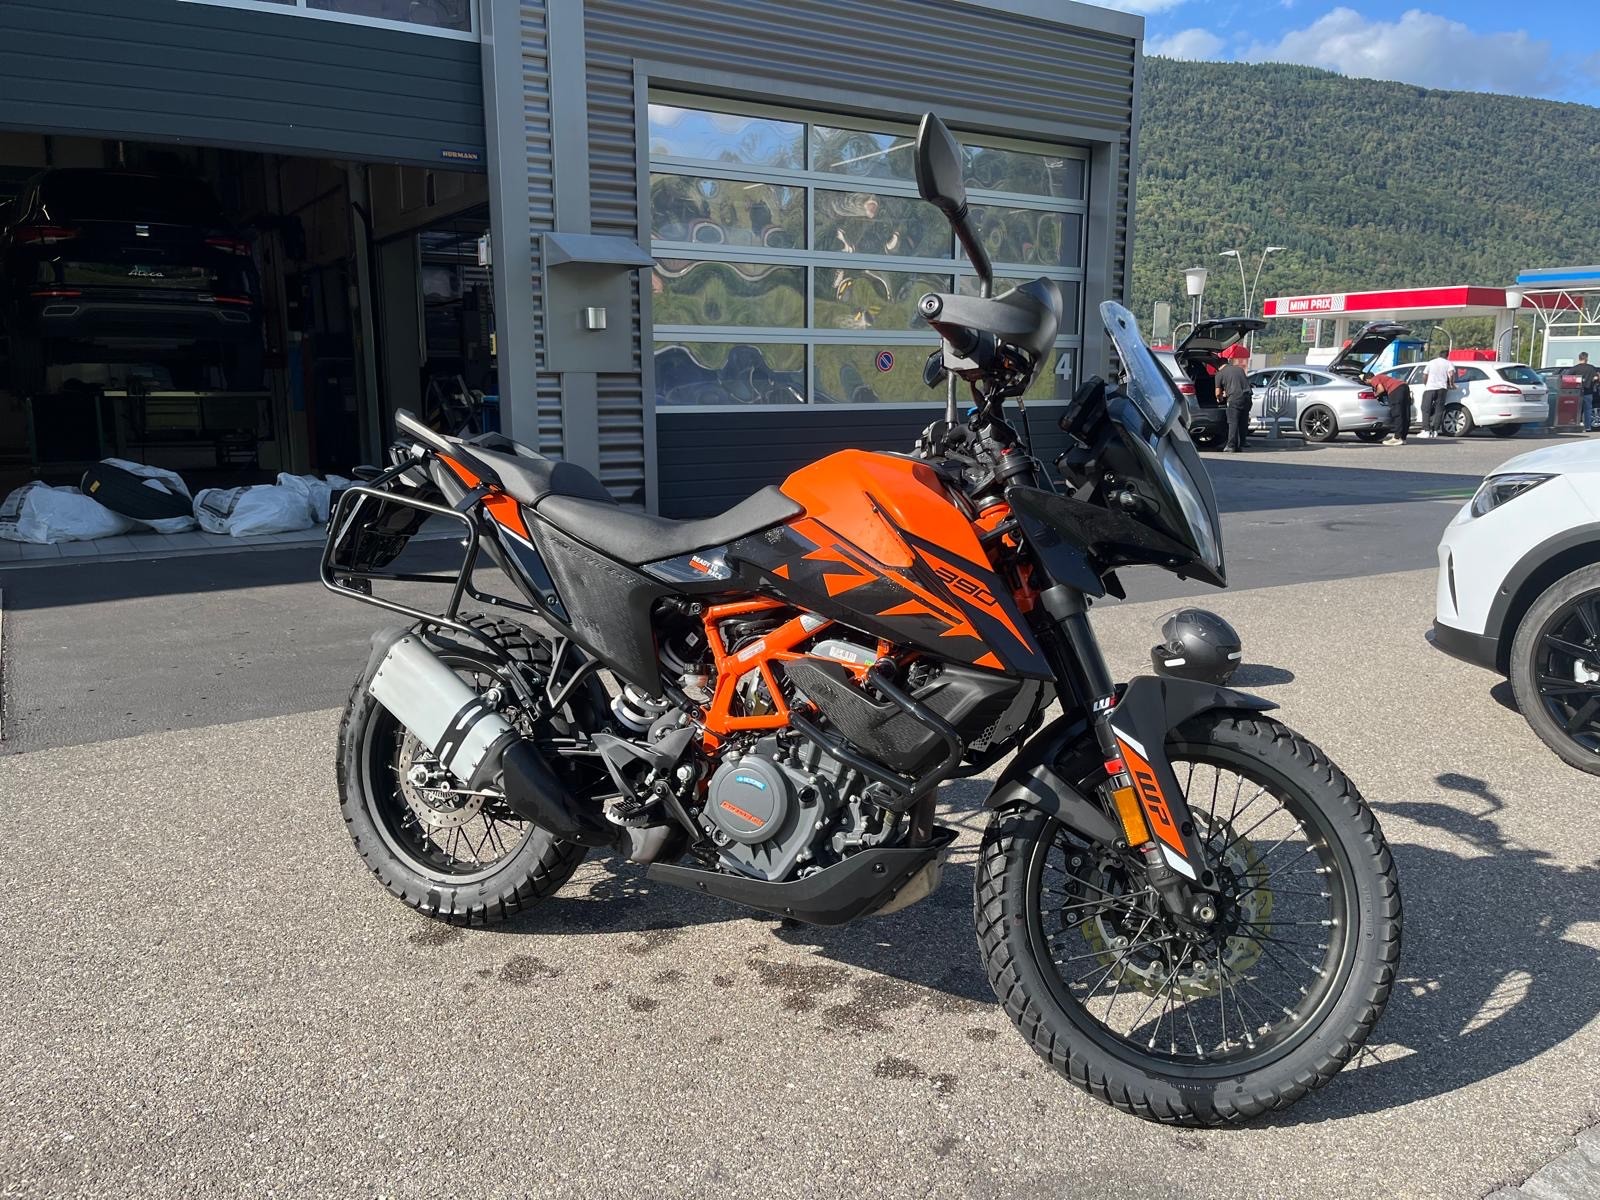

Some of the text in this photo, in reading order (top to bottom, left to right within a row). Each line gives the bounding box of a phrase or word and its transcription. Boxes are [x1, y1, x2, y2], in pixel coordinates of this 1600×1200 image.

[1289, 298, 1331, 311] MINI PRIX
[1055, 352, 1072, 380] 4
[691, 555, 711, 568] READY
[707, 568, 723, 580] RACE
[935, 566, 997, 607] 390
